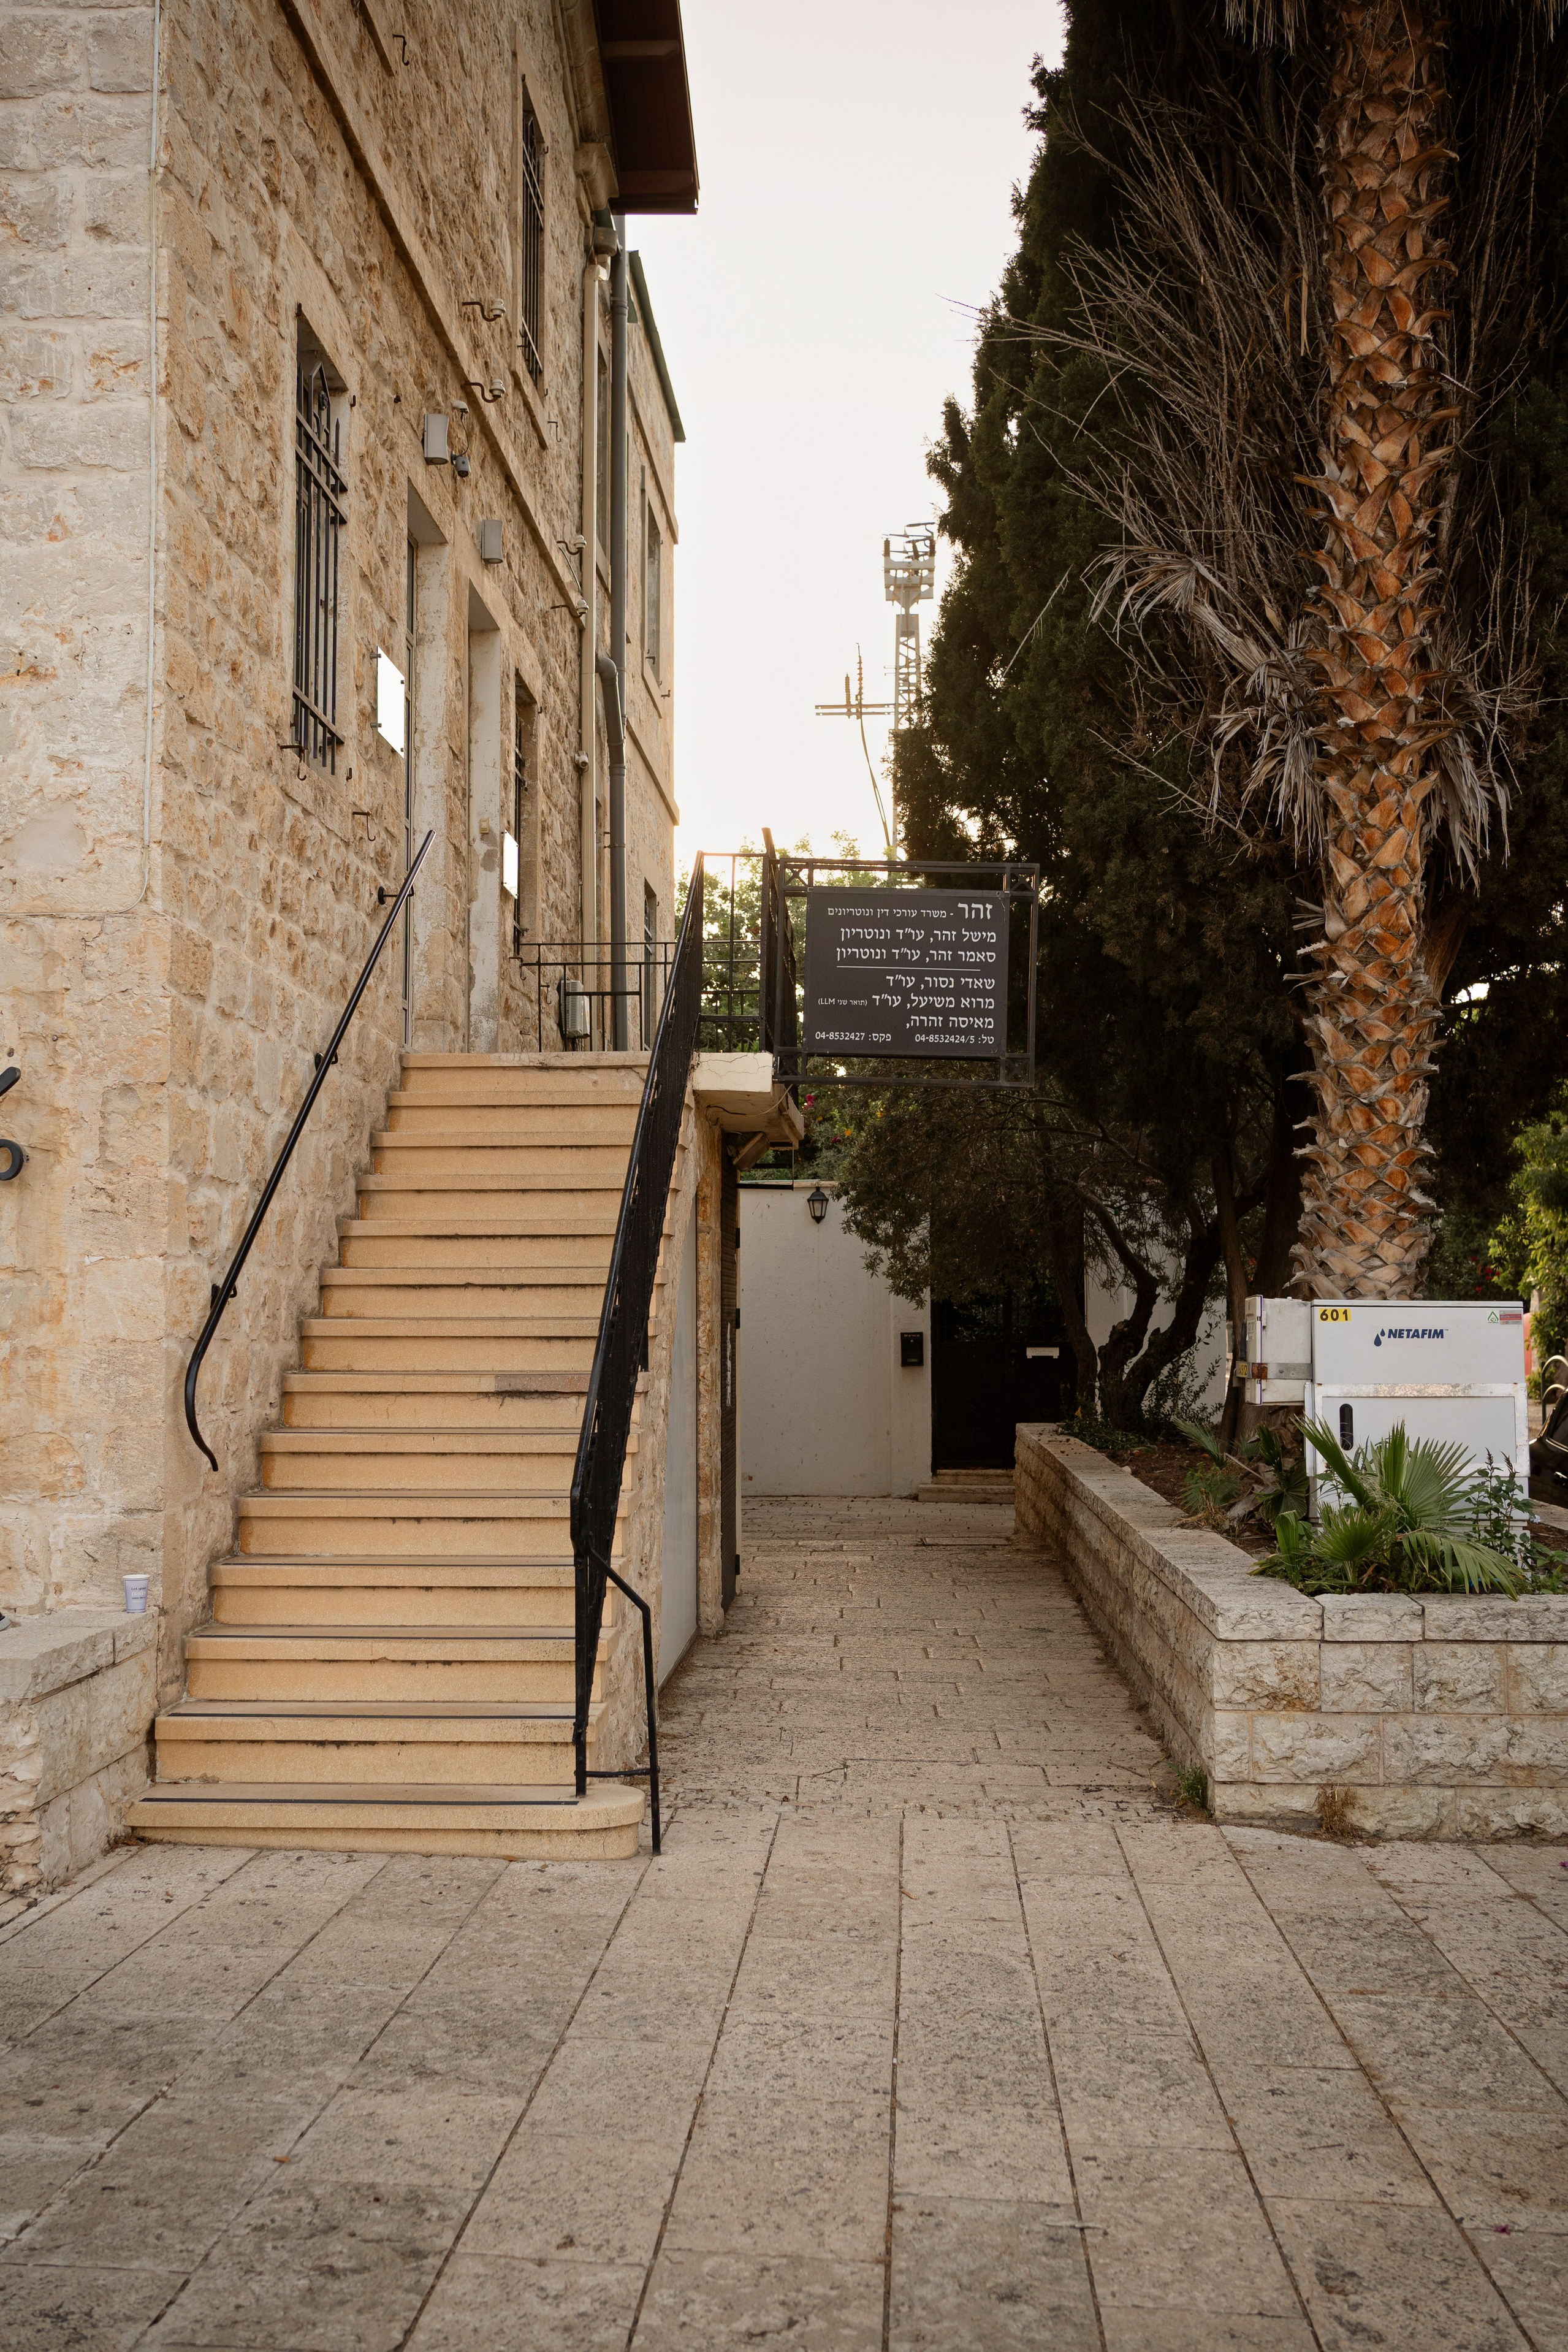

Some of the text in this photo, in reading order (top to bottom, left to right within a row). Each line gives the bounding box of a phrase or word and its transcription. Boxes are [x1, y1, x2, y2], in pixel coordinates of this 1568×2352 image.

[827, 907, 873, 916] ונוטריונים
[877, 908, 889, 918] דין
[892, 909, 918, 918] עורכי
[920, 909, 947, 918] משרד
[957, 902, 993, 920] זהר
[840, 927, 891, 942] ונוטריון
[929, 930, 957, 944] זהר,
[962, 928, 997, 942] מישל
[836, 947, 886, 961] ונוטריון
[926, 950, 953, 963] זהר,
[957, 950, 996, 963] סאמר
[920, 976, 954, 990] נסור,
[960, 977, 995, 990] שאדי
[907, 992, 955, 1010] משיעל,
[961, 997, 995, 1009] מרוא
[906, 1015, 994, 1029] מאיסה זהרה,
[815, 1031, 891, 1043] פקס: 04-8532427
[915, 1034, 994, 1044] טל: 04-8532424/5
[1320, 1309, 1349, 1321] 601
